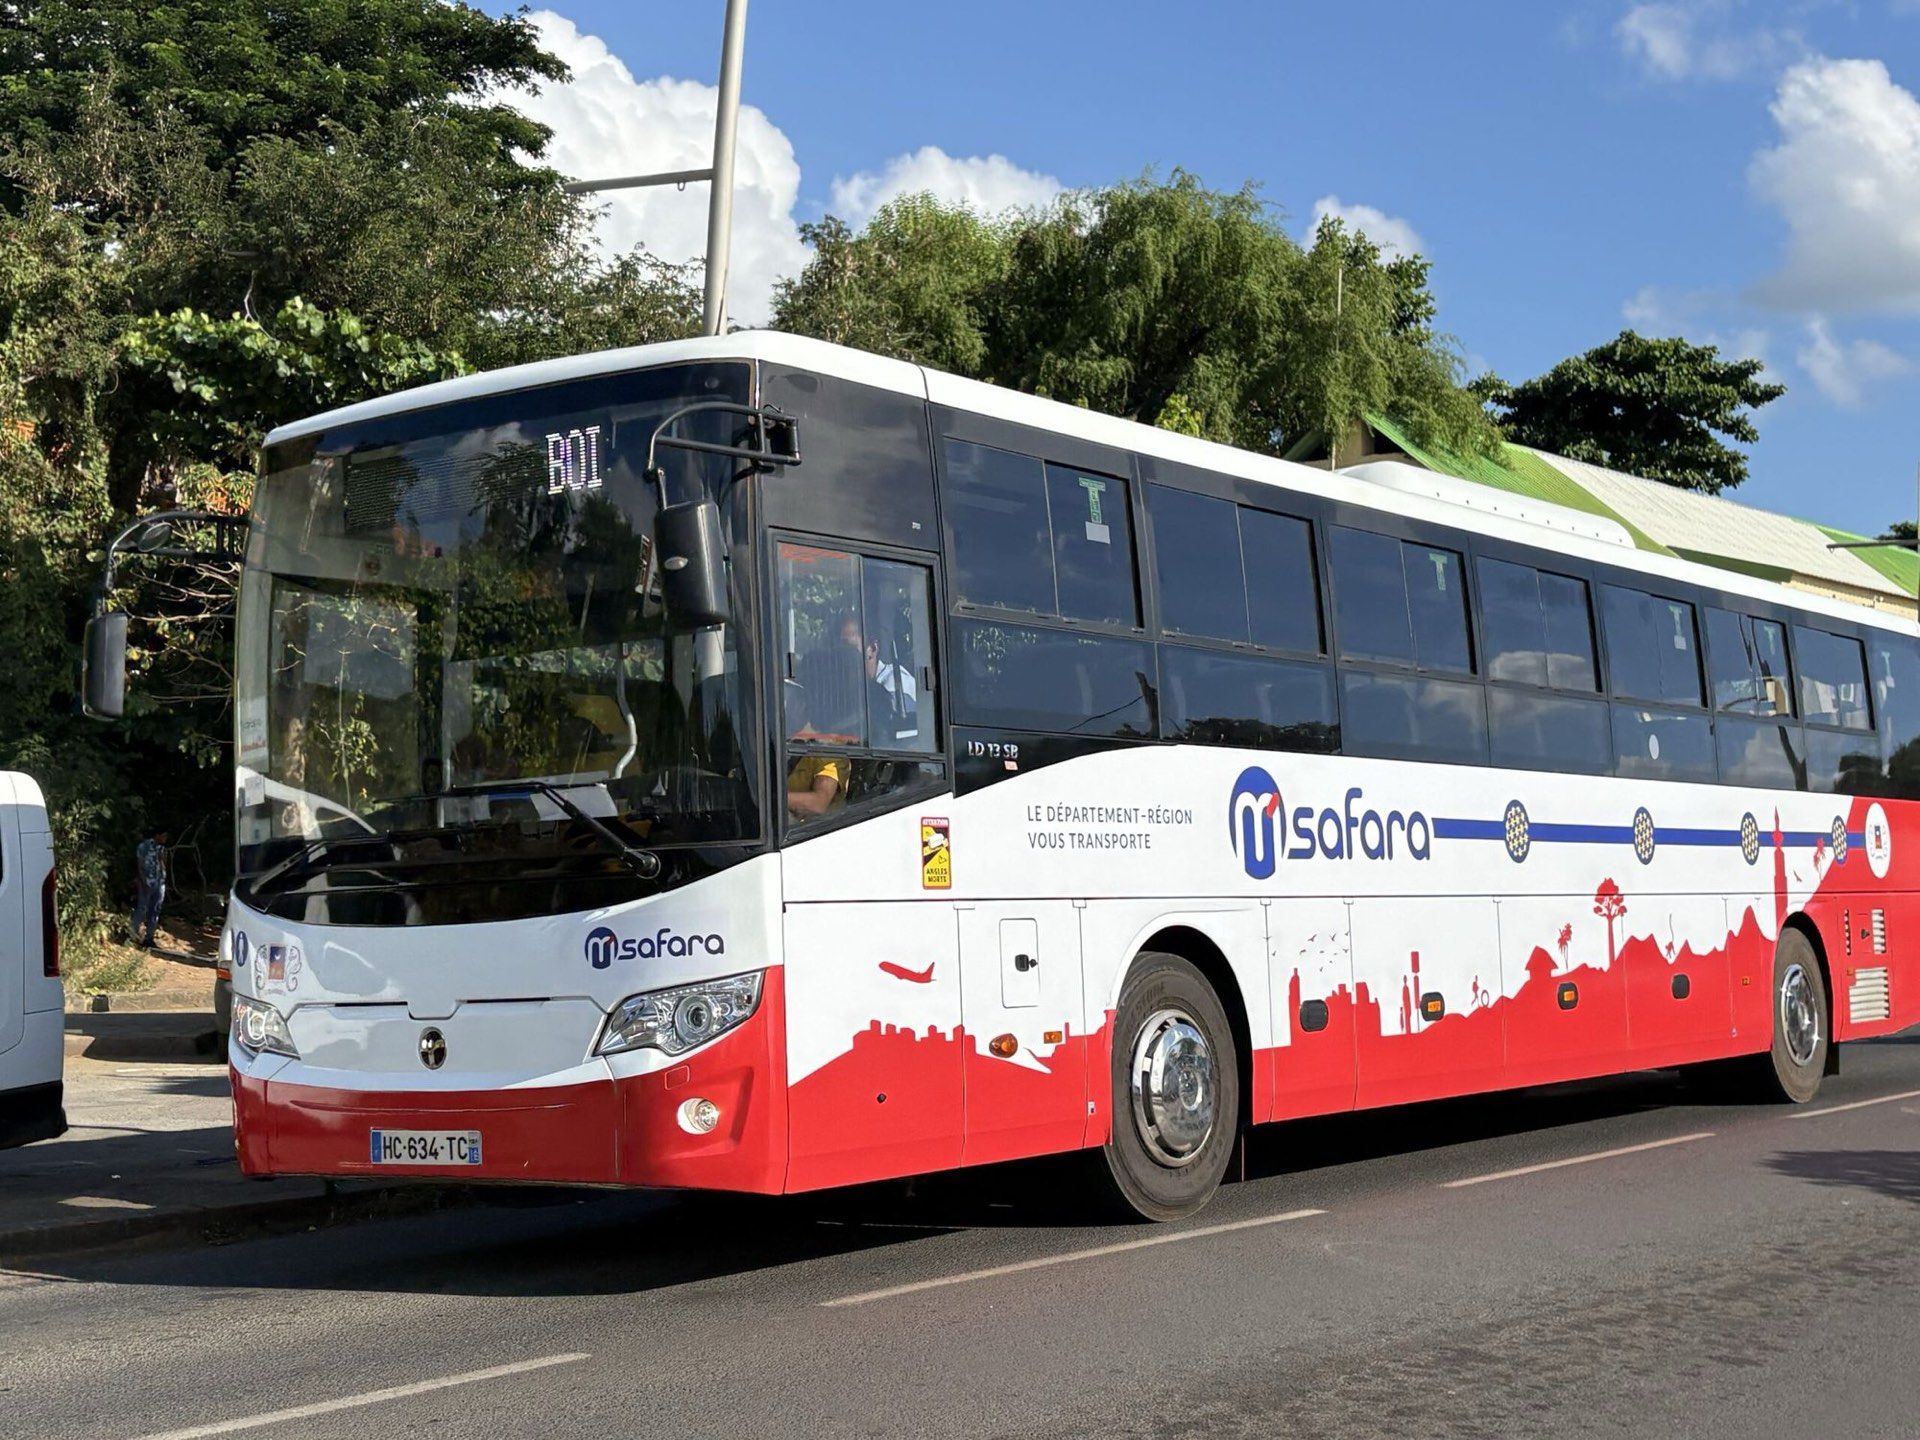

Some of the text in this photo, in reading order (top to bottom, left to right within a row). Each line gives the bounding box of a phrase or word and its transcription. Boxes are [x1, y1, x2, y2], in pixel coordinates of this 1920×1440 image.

[987, 743, 1001, 758] 13
[1003, 743, 1019, 759] SB
[1027, 802, 1193, 825] LE DÉPARTEMENT-RÉGION
[1028, 832, 1151, 849] VOUS TRANSPORTE
